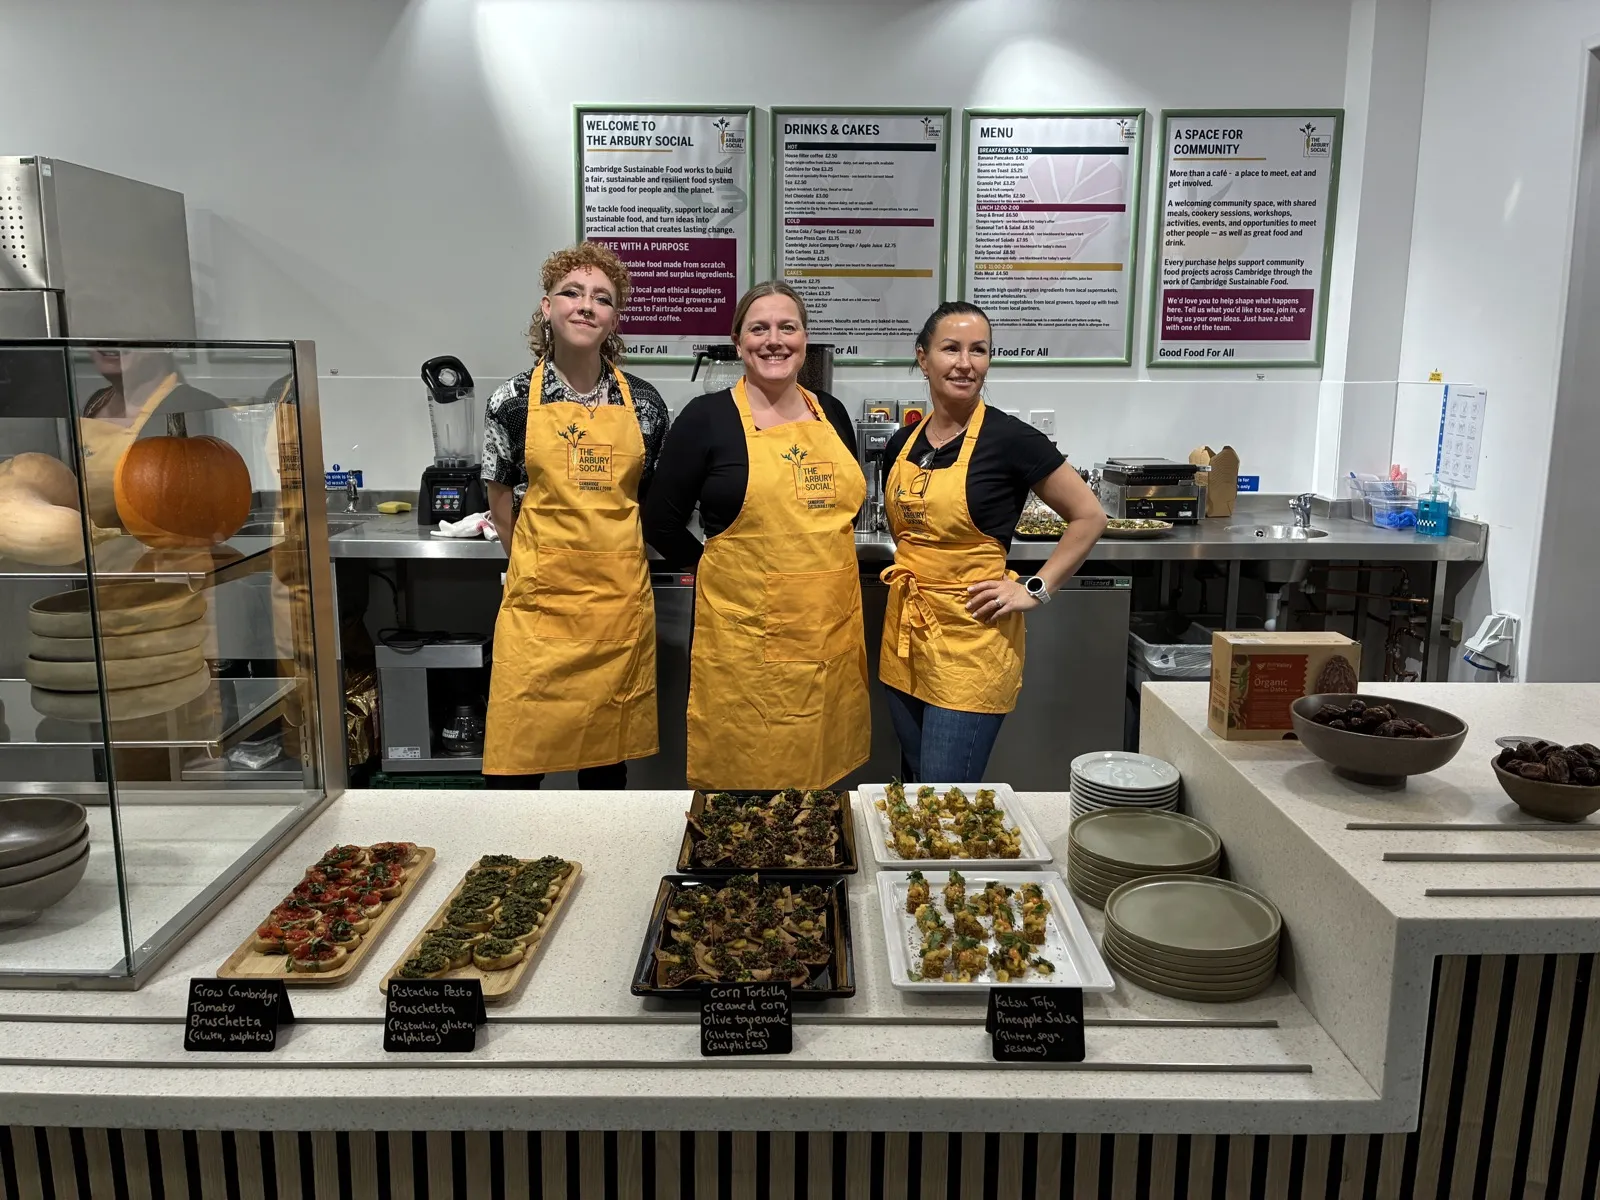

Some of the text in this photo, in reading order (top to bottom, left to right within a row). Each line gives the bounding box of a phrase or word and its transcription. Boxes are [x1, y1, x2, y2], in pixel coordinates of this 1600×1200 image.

[586, 121, 656, 131] WELCOME TO
[785, 124, 879, 135] DRINKS & CAKES
[981, 127, 1013, 138] MENU
[1175, 130, 1243, 139] A SPACE FOR
[586, 136, 694, 146] THE ARBURY SOCIAL
[1174, 144, 1239, 154] COMMUNITY
[584, 165, 622, 175] Cambridge
[1175, 200, 1211, 208] welcoming
[640, 345, 654, 353] For
[835, 346, 844, 354] or
[998, 348, 1019, 356] Food
[1159, 348, 1181, 356] Good
[579, 448, 594, 456] THE
[803, 467, 818, 475] THE
[804, 474, 833, 483] ARBURY
[805, 483, 832, 491] SOCIAL
[1254, 678, 1288, 688] Organic
[194, 984, 278, 1006] Grow Cambridge
[391, 984, 472, 998] Pistachio Pesto
[711, 986, 787, 1000] Corn Tortilla,
[995, 994, 1028, 1008] Katsu
[190, 1002, 235, 1012] Tomato
[389, 1001, 455, 1014] Bruschetta
[704, 1000, 788, 1015] creamed corn,
[191, 1015, 261, 1027] Bruschetta
[734, 1014, 789, 1030] tapenade
[997, 1011, 1078, 1028] Pineapple Salsa
[389, 1018, 475, 1034] (Pistachio, gluten,
[230, 1030, 274, 1044] sulphites)
[391, 1032, 441, 1045] sulphites)
[705, 1028, 770, 1040] (Gluten free)
[1038, 1032, 1064, 1043] soya,
[707, 1039, 768, 1052] (sulphites)
[1004, 1044, 1047, 1056] sesame)
